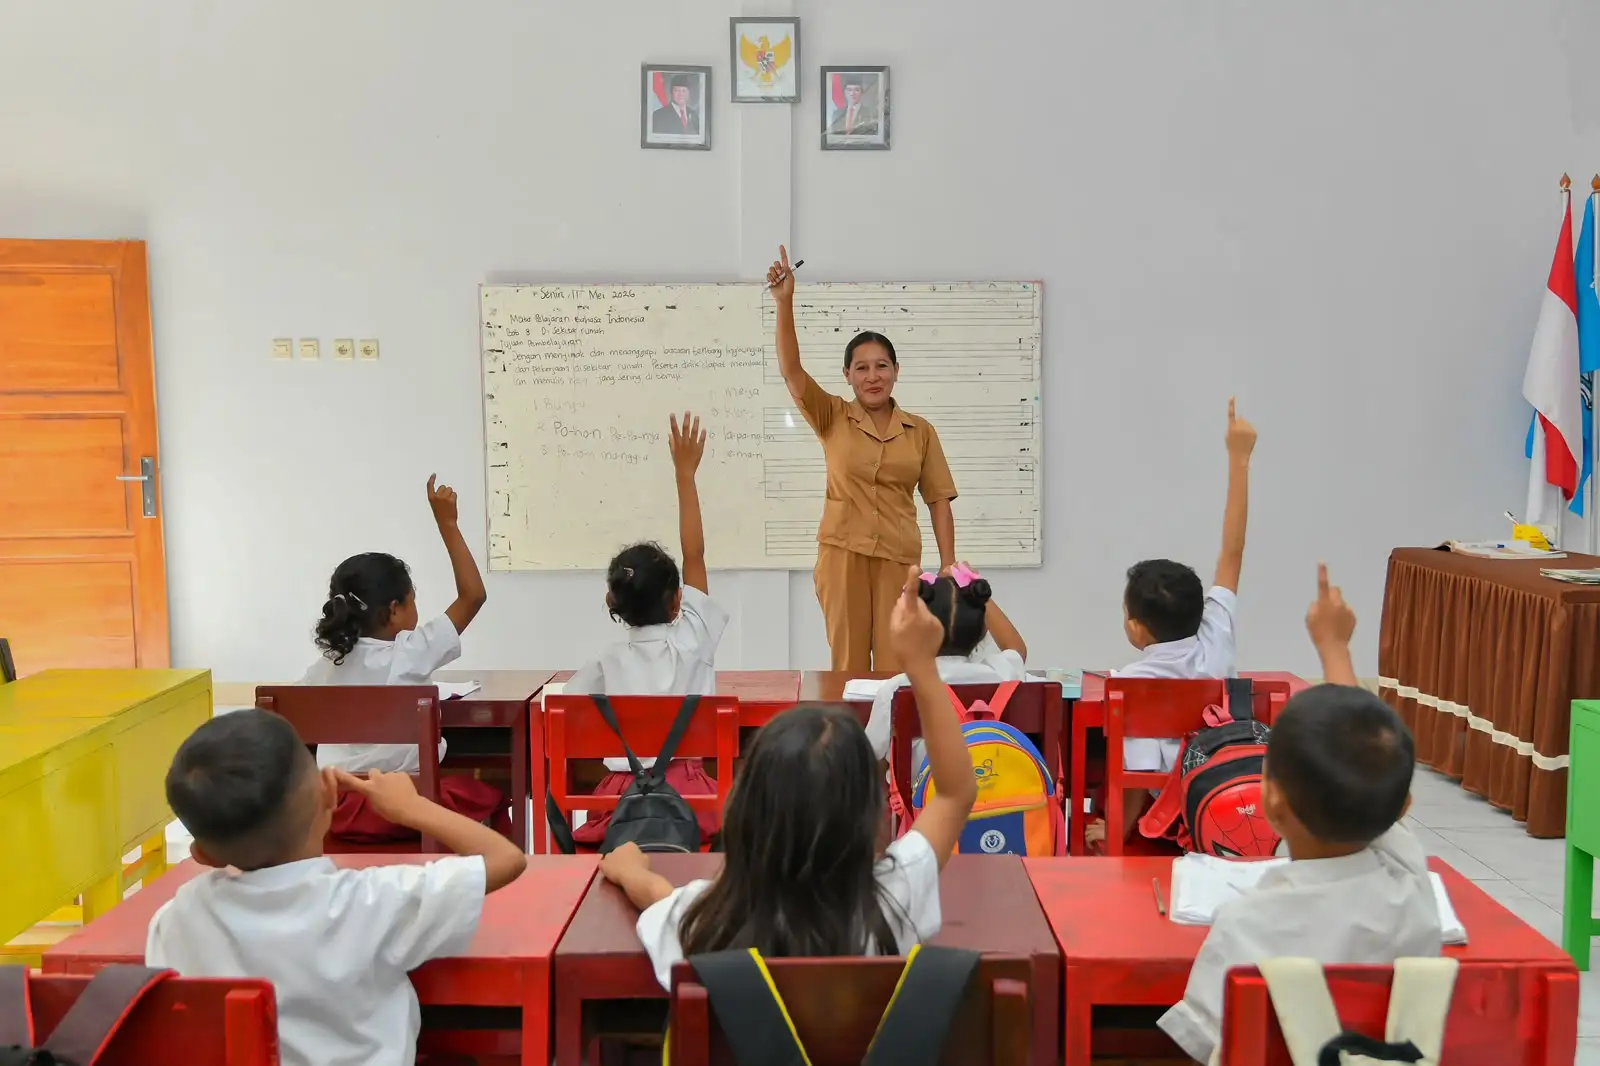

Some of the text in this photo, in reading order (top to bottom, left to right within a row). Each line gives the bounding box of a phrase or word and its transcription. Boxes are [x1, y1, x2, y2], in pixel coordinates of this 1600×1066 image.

[588, 289, 605, 299] Mei
[612, 289, 636, 299] 2026
[605, 313, 645, 324] Indonesia
[589, 347, 605, 358] dan
